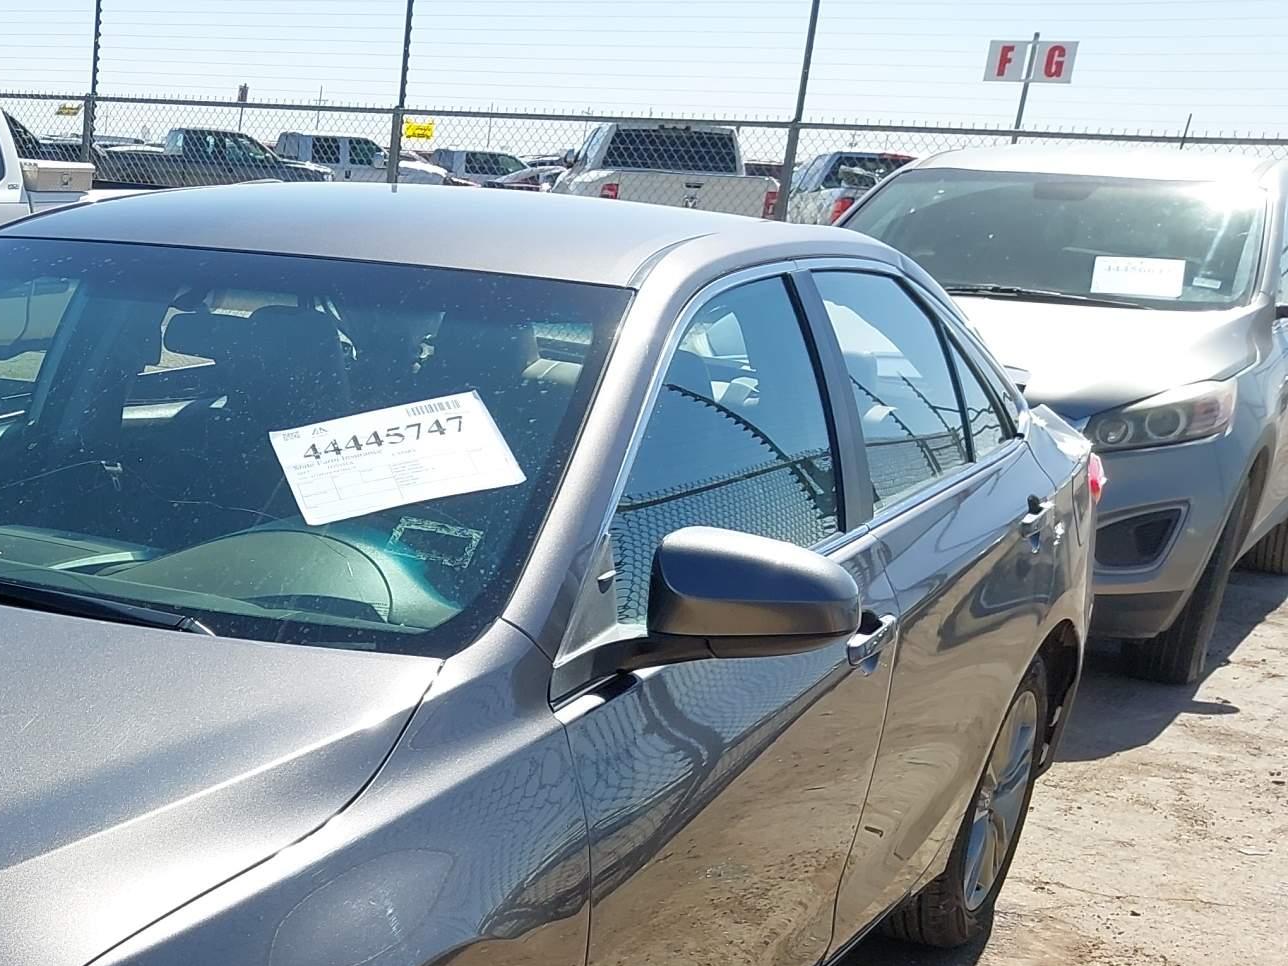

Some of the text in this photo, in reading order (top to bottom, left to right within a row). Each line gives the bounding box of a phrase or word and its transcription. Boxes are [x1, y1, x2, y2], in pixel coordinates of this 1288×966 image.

[996, 45, 1016, 77] F
[1044, 45, 1066, 78] G
[303, 415, 464, 460] 44445747
